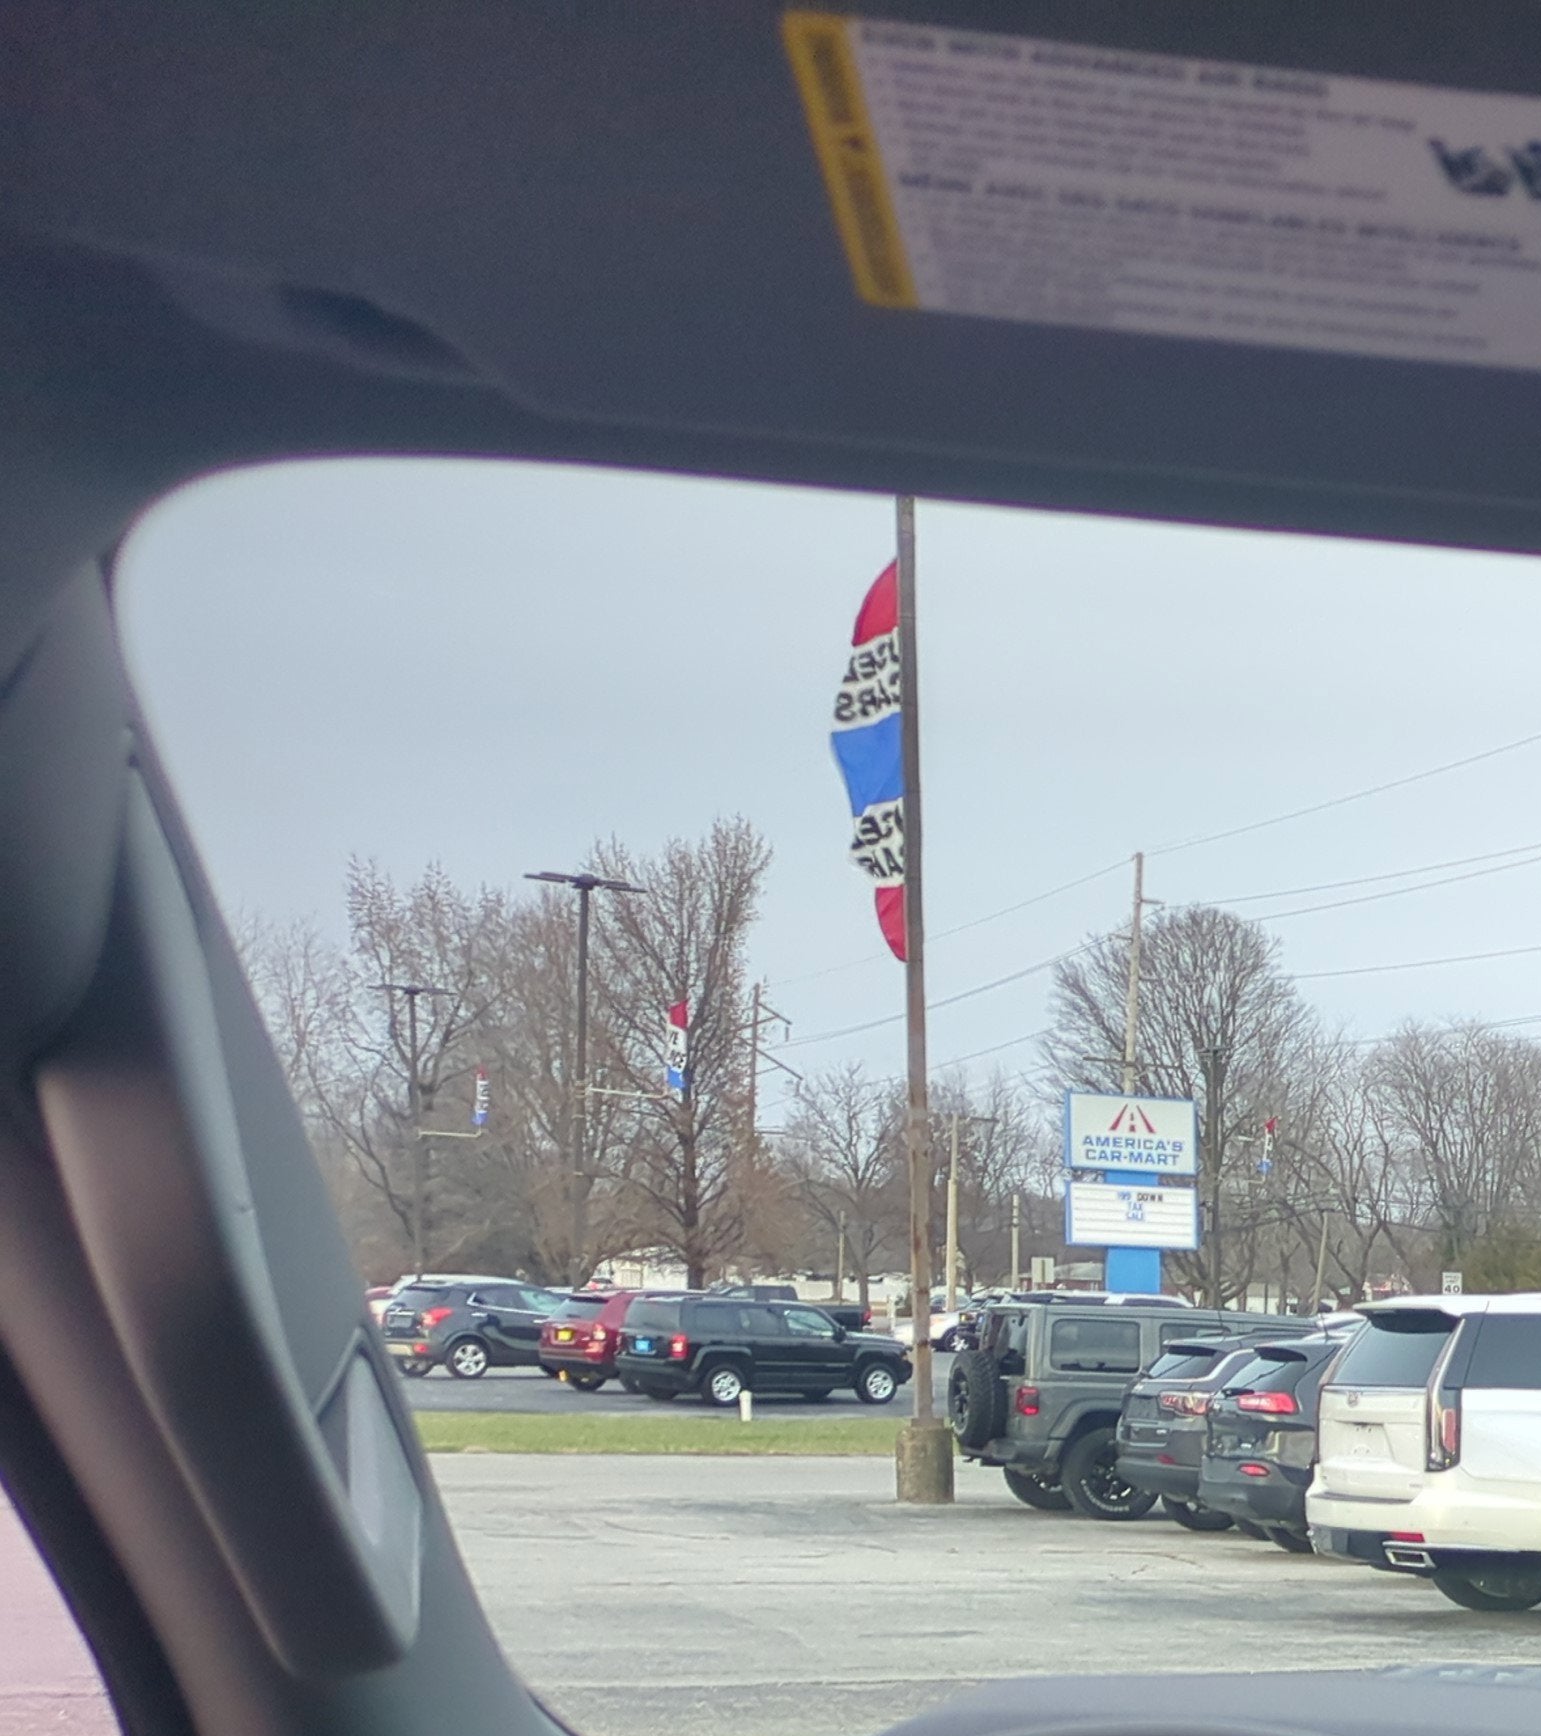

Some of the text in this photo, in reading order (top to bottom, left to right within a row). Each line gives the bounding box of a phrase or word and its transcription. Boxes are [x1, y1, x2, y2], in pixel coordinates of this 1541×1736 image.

[1082, 1135, 1184, 1152] AMERICA'S
[1085, 1149, 1180, 1166] CAR-MART
[1444, 1284, 1460, 1294] 40
